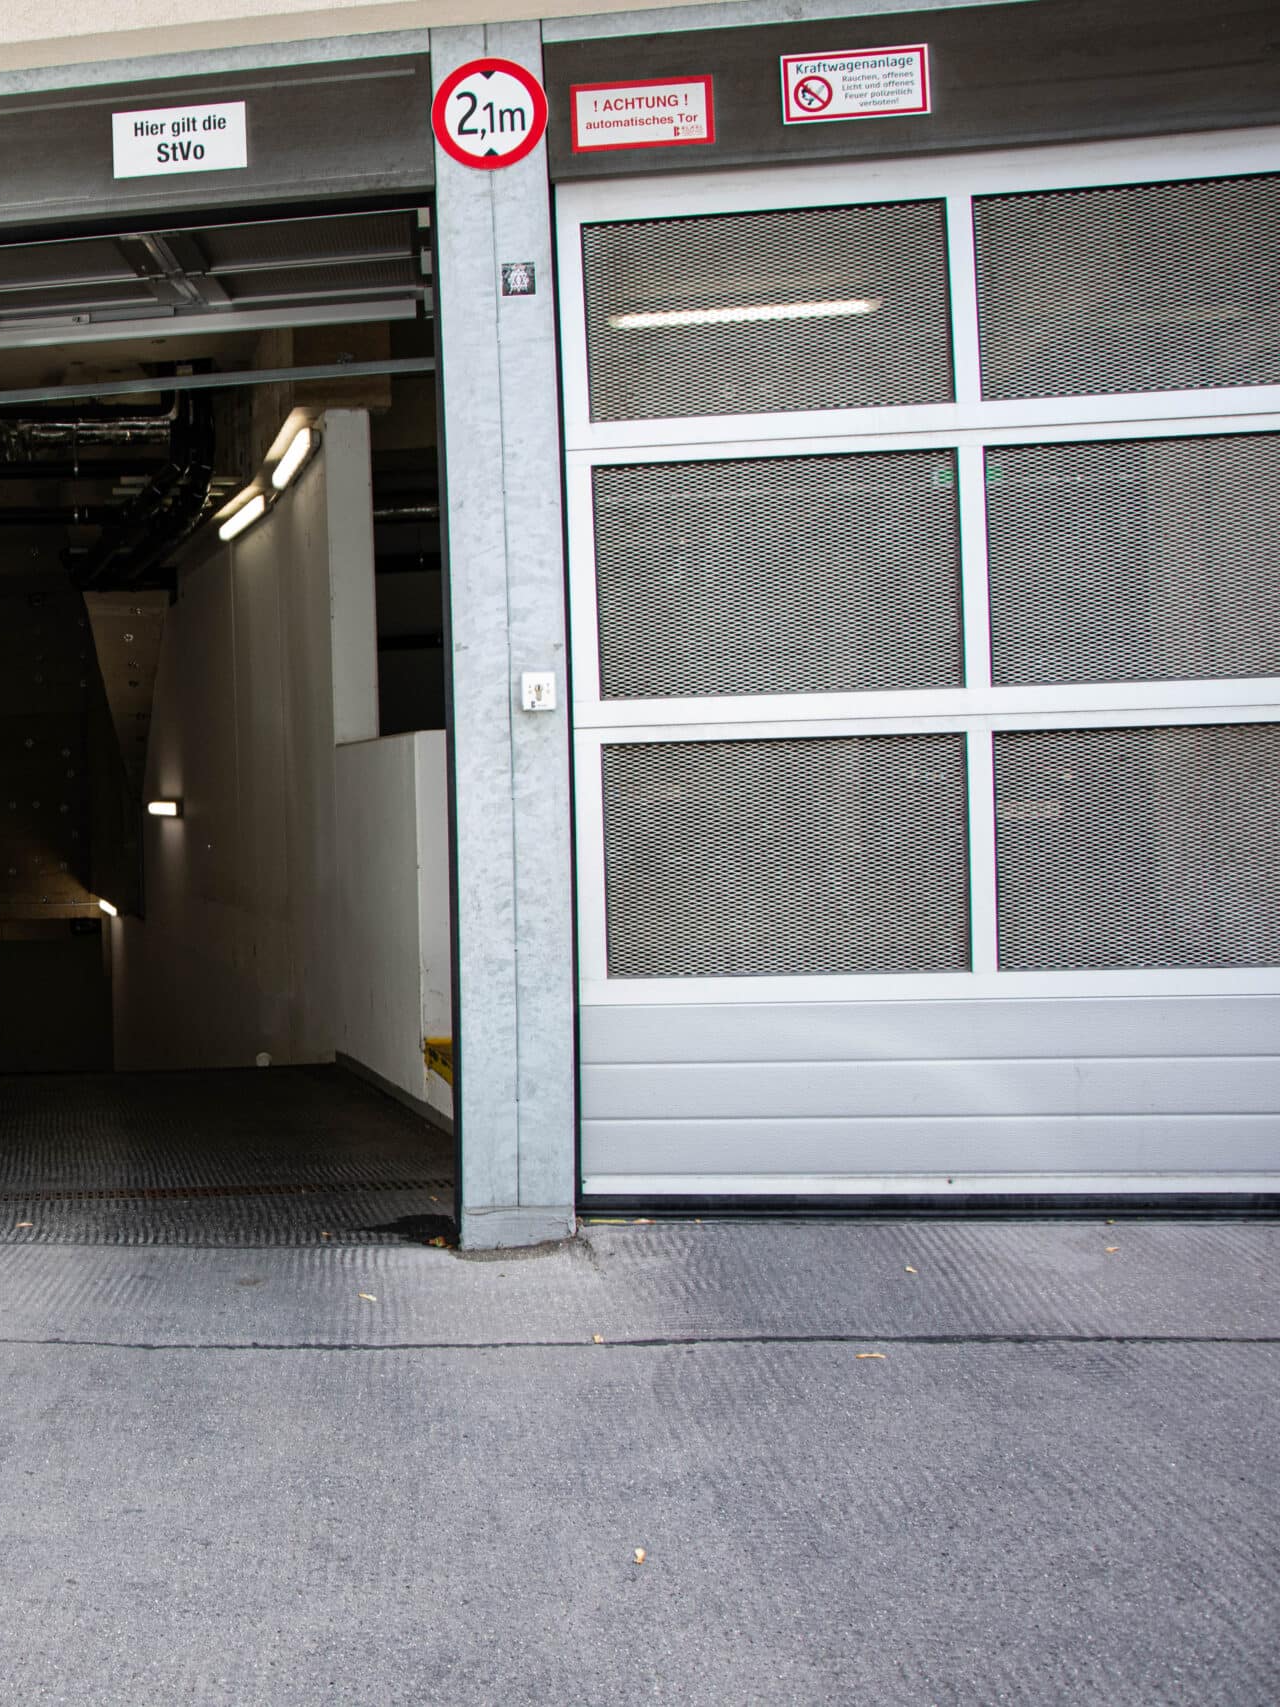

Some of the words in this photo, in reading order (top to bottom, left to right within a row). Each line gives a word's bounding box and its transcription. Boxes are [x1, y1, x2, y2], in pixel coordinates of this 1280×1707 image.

[796, 56, 914, 75] Kraftwagenanlage
[882, 71, 914, 79] offenes
[842, 82, 863, 91] Licht
[865, 81, 881, 89] und
[883, 79, 915, 88] offenes
[844, 91, 868, 99] Feuer
[870, 88, 913, 99] polizeilich
[602, 94, 679, 112] ACHTUNG
[456, 91, 526, 140] 2,1m
[585, 115, 674, 130] automatisches
[677, 113, 699, 124] Tor
[134, 120, 166, 137] Hier
[171, 117, 197, 137] gilt
[202, 115, 227, 131] die
[157, 141, 205, 163] StVo
